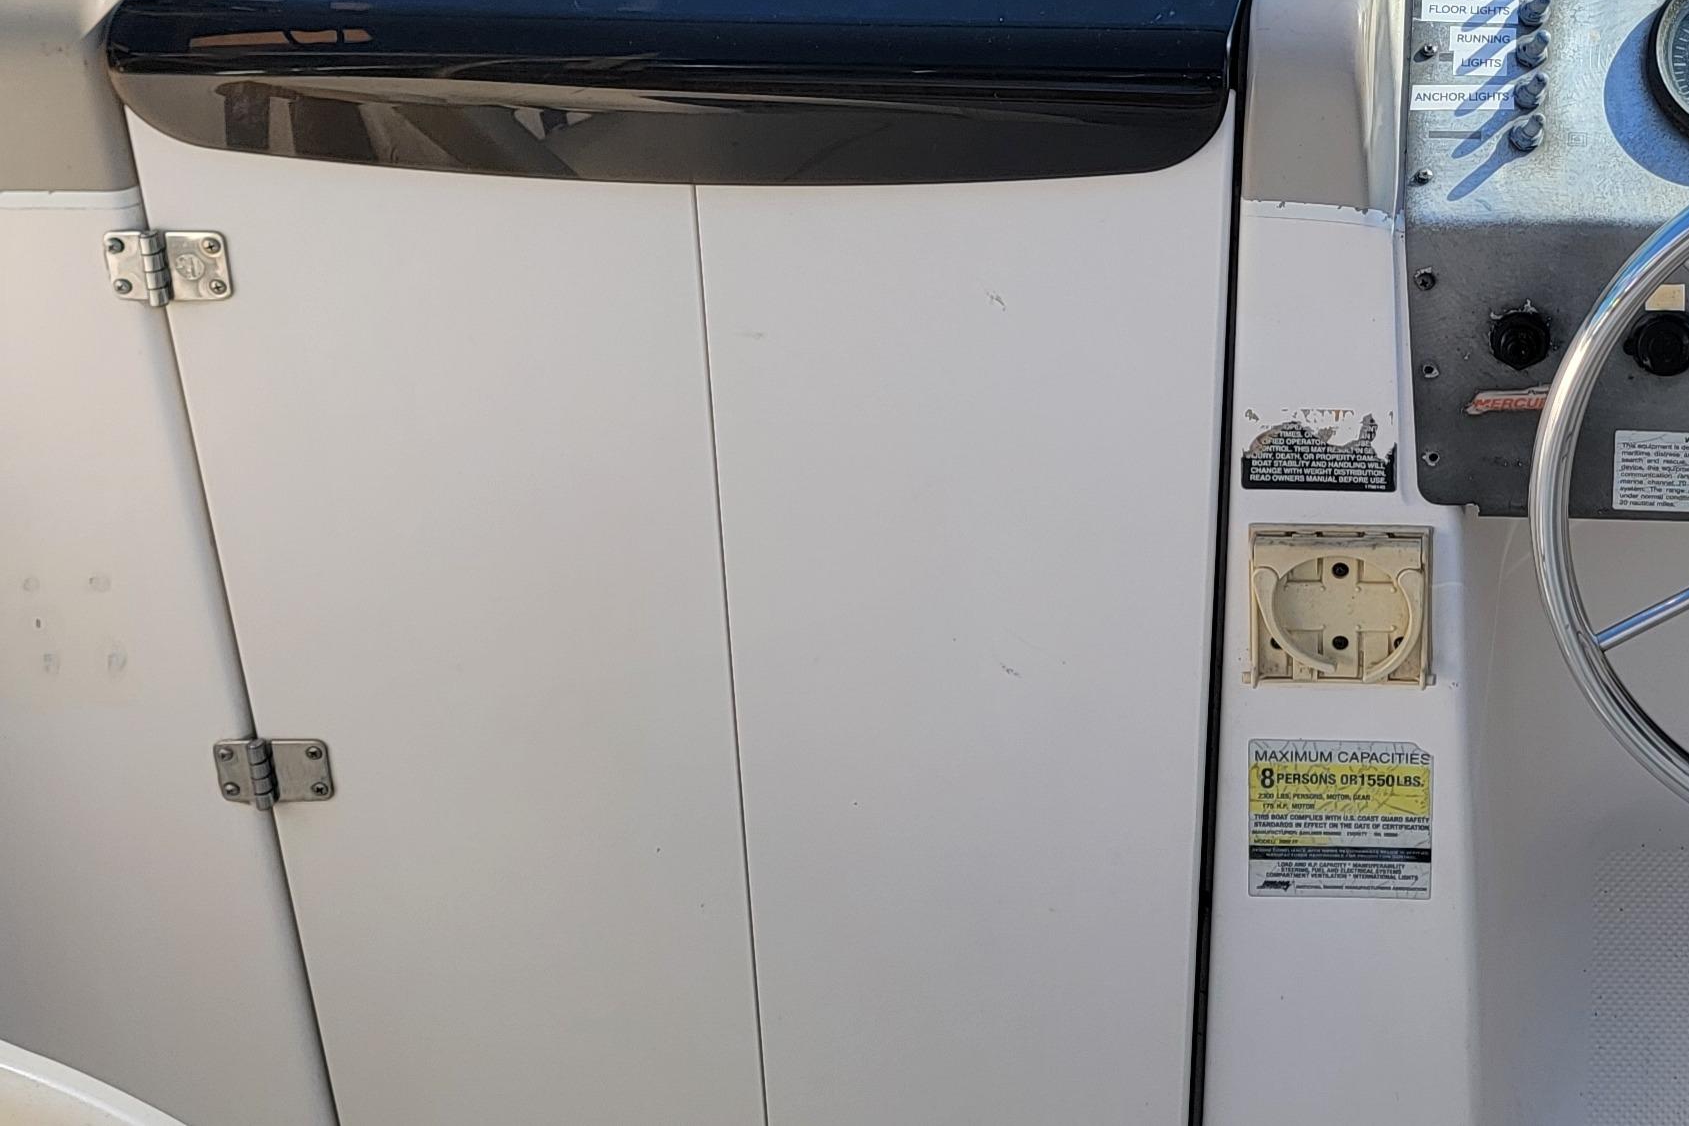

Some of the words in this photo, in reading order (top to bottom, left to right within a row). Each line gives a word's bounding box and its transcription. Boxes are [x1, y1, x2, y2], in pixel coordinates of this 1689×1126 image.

[1429, 4, 1467, 14] FLOOR
[1470, 5, 1510, 16] LIGHTS
[1456, 34, 1511, 44] RUNNING
[1461, 57, 1502, 68] LIGHTS
[1415, 92, 1466, 102] ANCHOR
[1468, 92, 1510, 103] LIGHTS
[1306, 475, 1337, 483] MANUAL
[1254, 750, 1332, 763] MAXIMUM
[1338, 751, 1430, 766] CAPACITIES
[1260, 767, 1275, 789] 8
[1276, 773, 1337, 786] PERSONS
[1340, 774, 1357, 786] OR
[1359, 773, 1394, 788] 1550
[1396, 775, 1425, 788] LBS.
